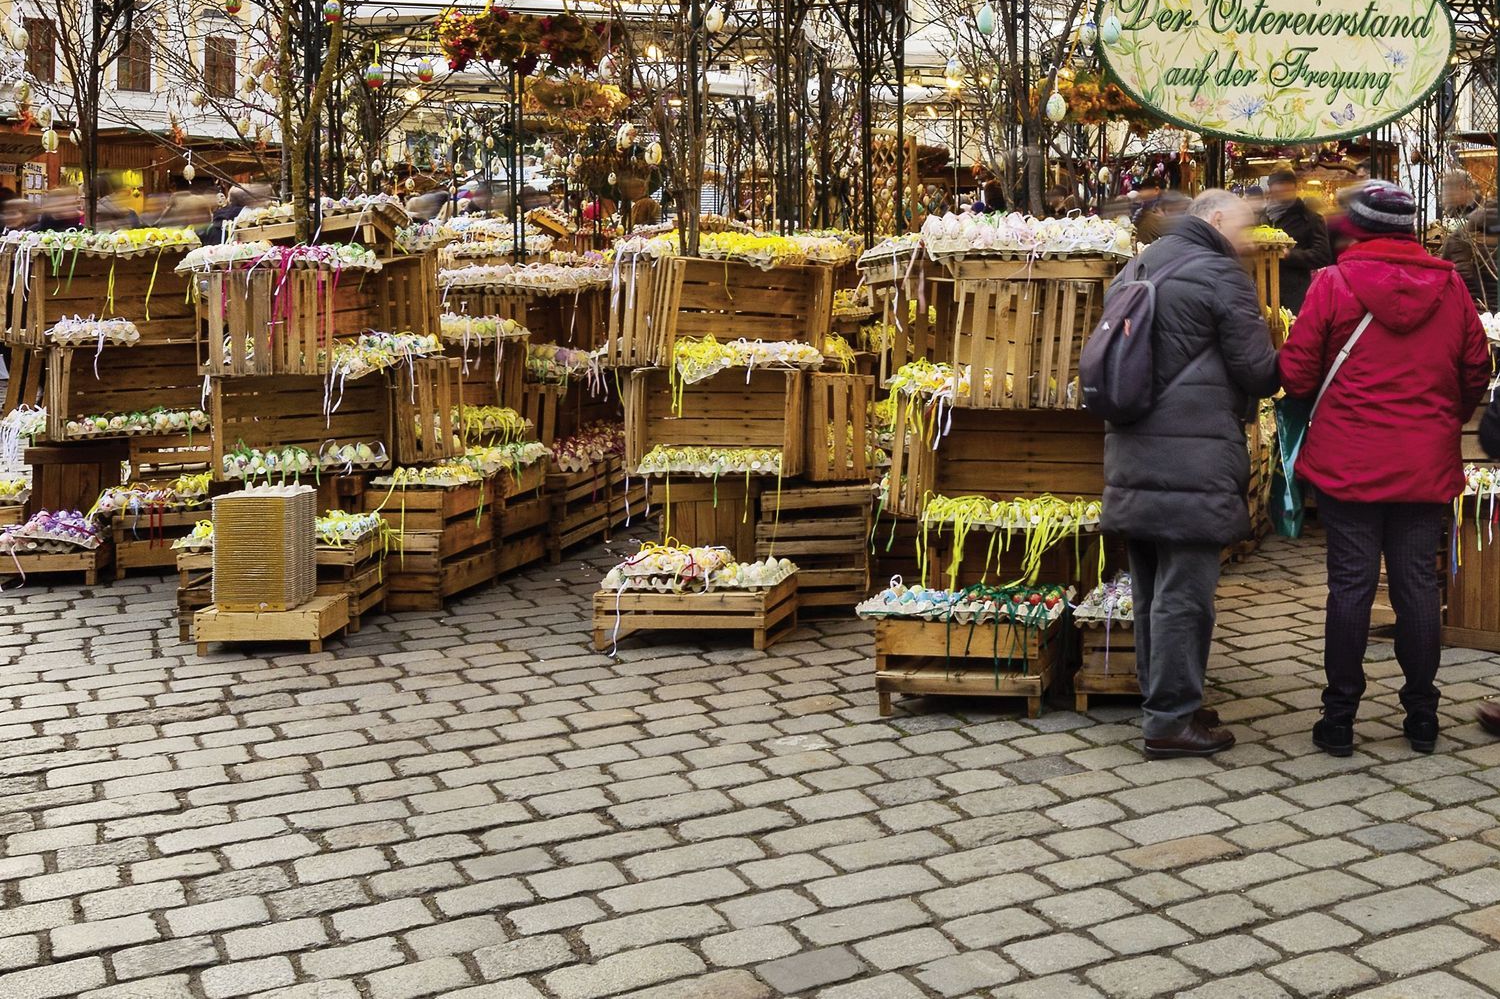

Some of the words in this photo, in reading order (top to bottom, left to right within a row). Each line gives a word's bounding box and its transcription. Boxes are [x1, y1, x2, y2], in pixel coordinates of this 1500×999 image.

[1165, 46, 1217, 100] auf
[1214, 48, 1259, 88] der
[1268, 47, 1392, 106] Freyung
